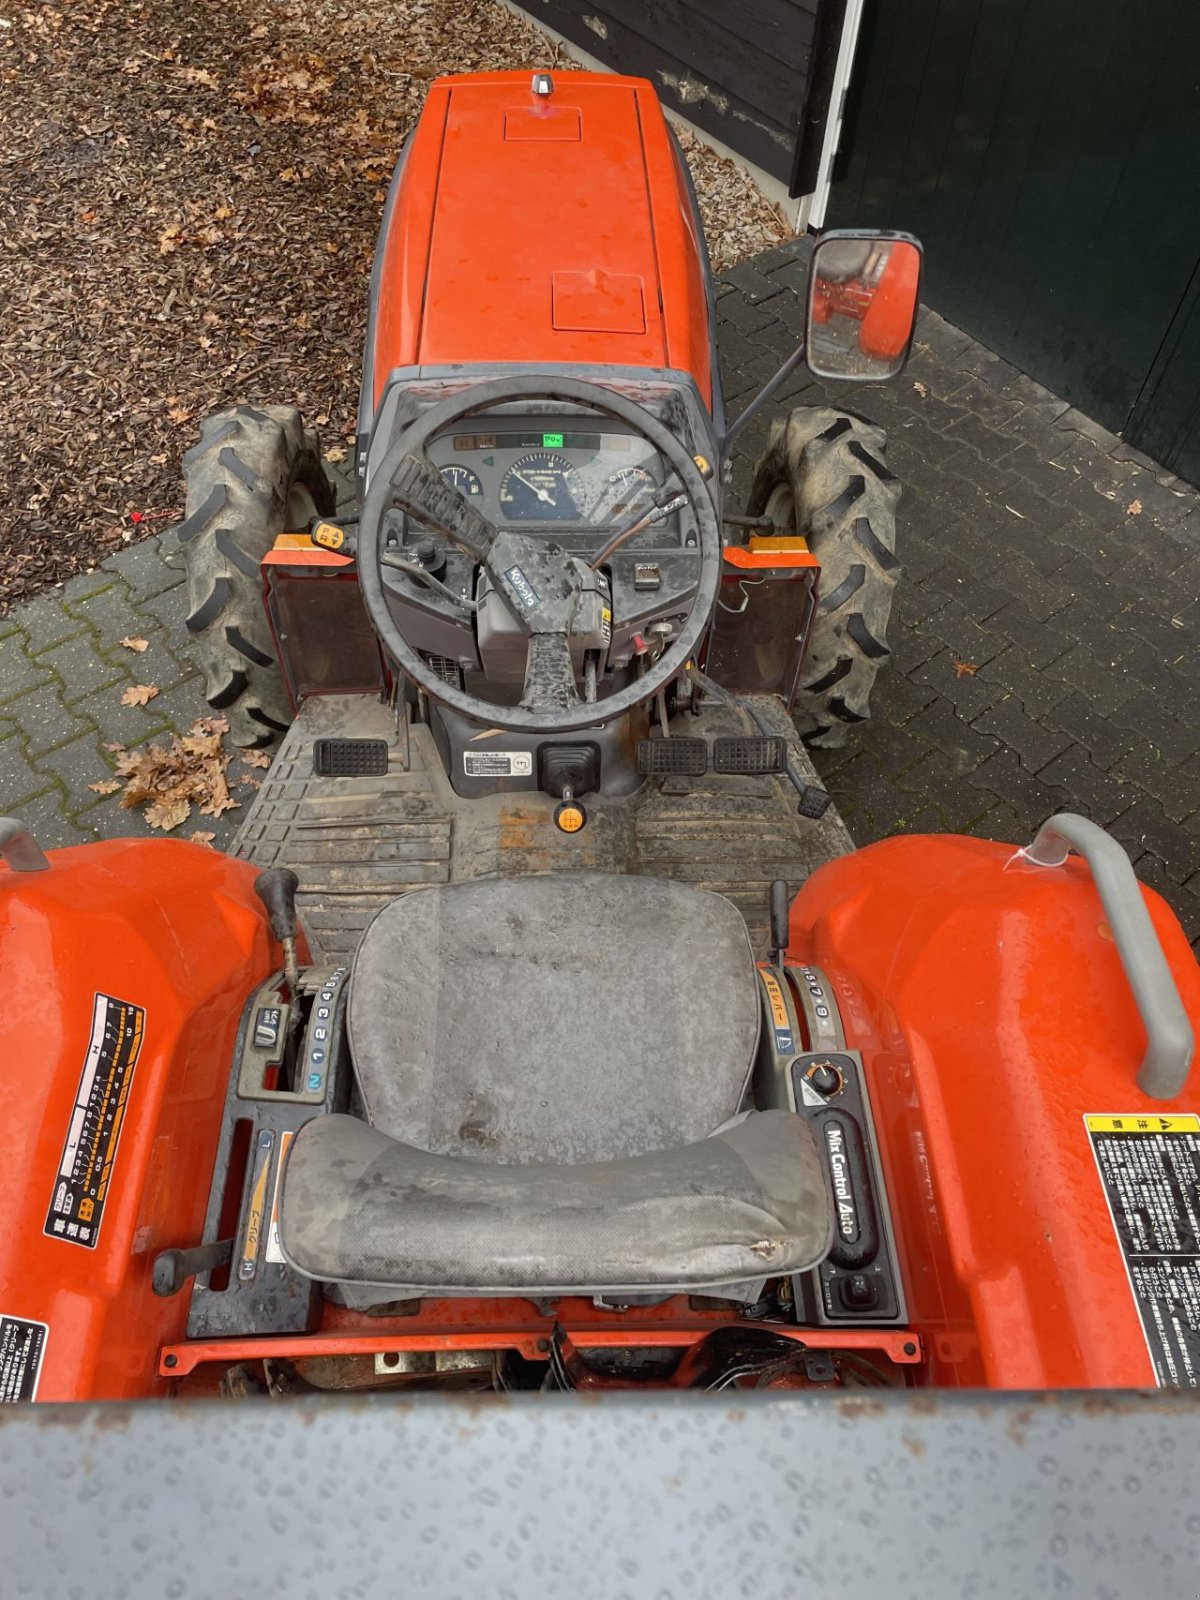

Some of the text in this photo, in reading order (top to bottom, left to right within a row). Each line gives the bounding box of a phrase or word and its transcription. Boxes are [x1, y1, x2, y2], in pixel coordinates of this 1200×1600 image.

[511, 569, 534, 606] Kubota
[322, 992, 332, 1001] 4
[318, 1008, 328, 1018] 3
[816, 1007, 828, 1016] 9
[316, 1028, 326, 1040] 2
[92, 1045, 100, 1054] H
[308, 1076, 320, 1088] N
[828, 1130, 854, 1234] Mix Control Auto
[249, 1210, 260, 1243] クリープ
[244, 1263, 252, 1271] H
